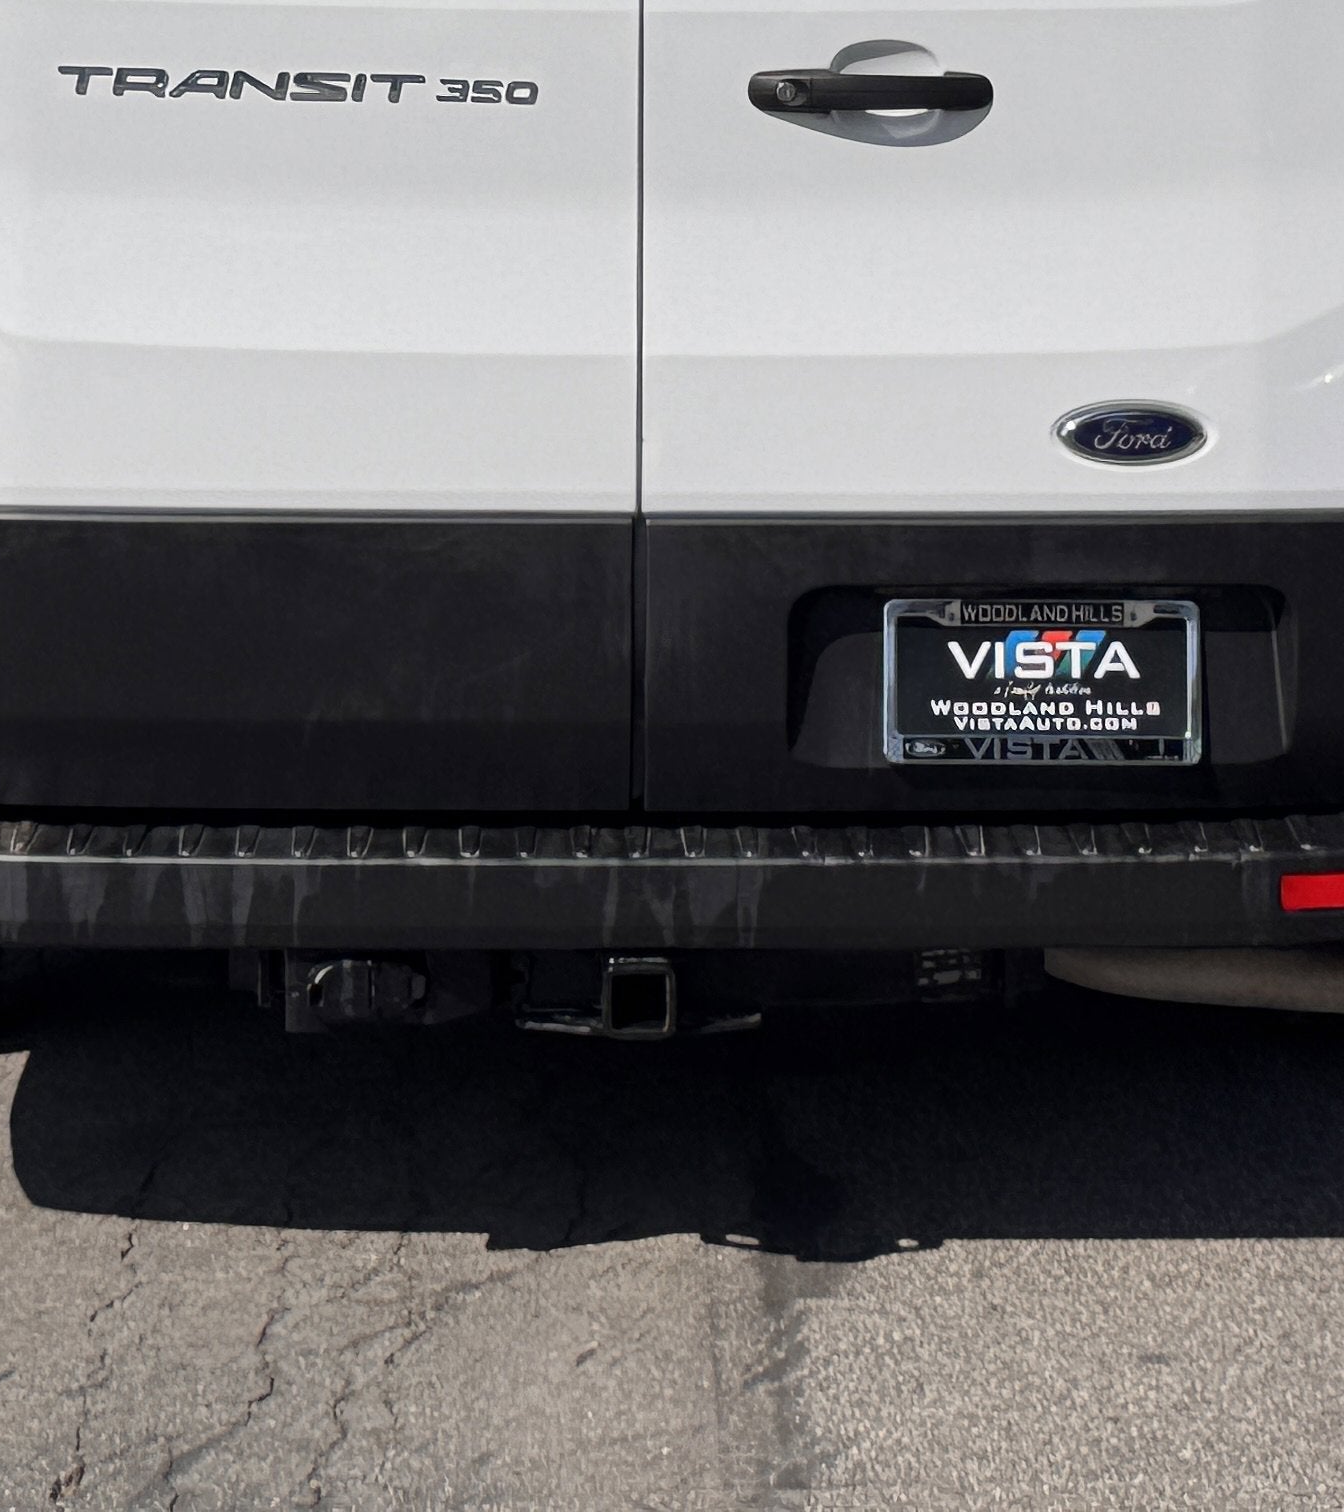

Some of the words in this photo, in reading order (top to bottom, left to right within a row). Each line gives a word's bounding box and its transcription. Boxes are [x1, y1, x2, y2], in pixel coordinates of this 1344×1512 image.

[58, 66, 425, 104] TRANSIT
[436, 78, 539, 106] 350
[1093, 418, 1172, 449] Ford
[963, 604, 1068, 622] WOODLAND
[1072, 604, 1123, 622] HILLS
[947, 641, 1140, 679] VISTA
[931, 699, 1074, 716] WOODLAND
[964, 738, 1089, 760] VISTA
